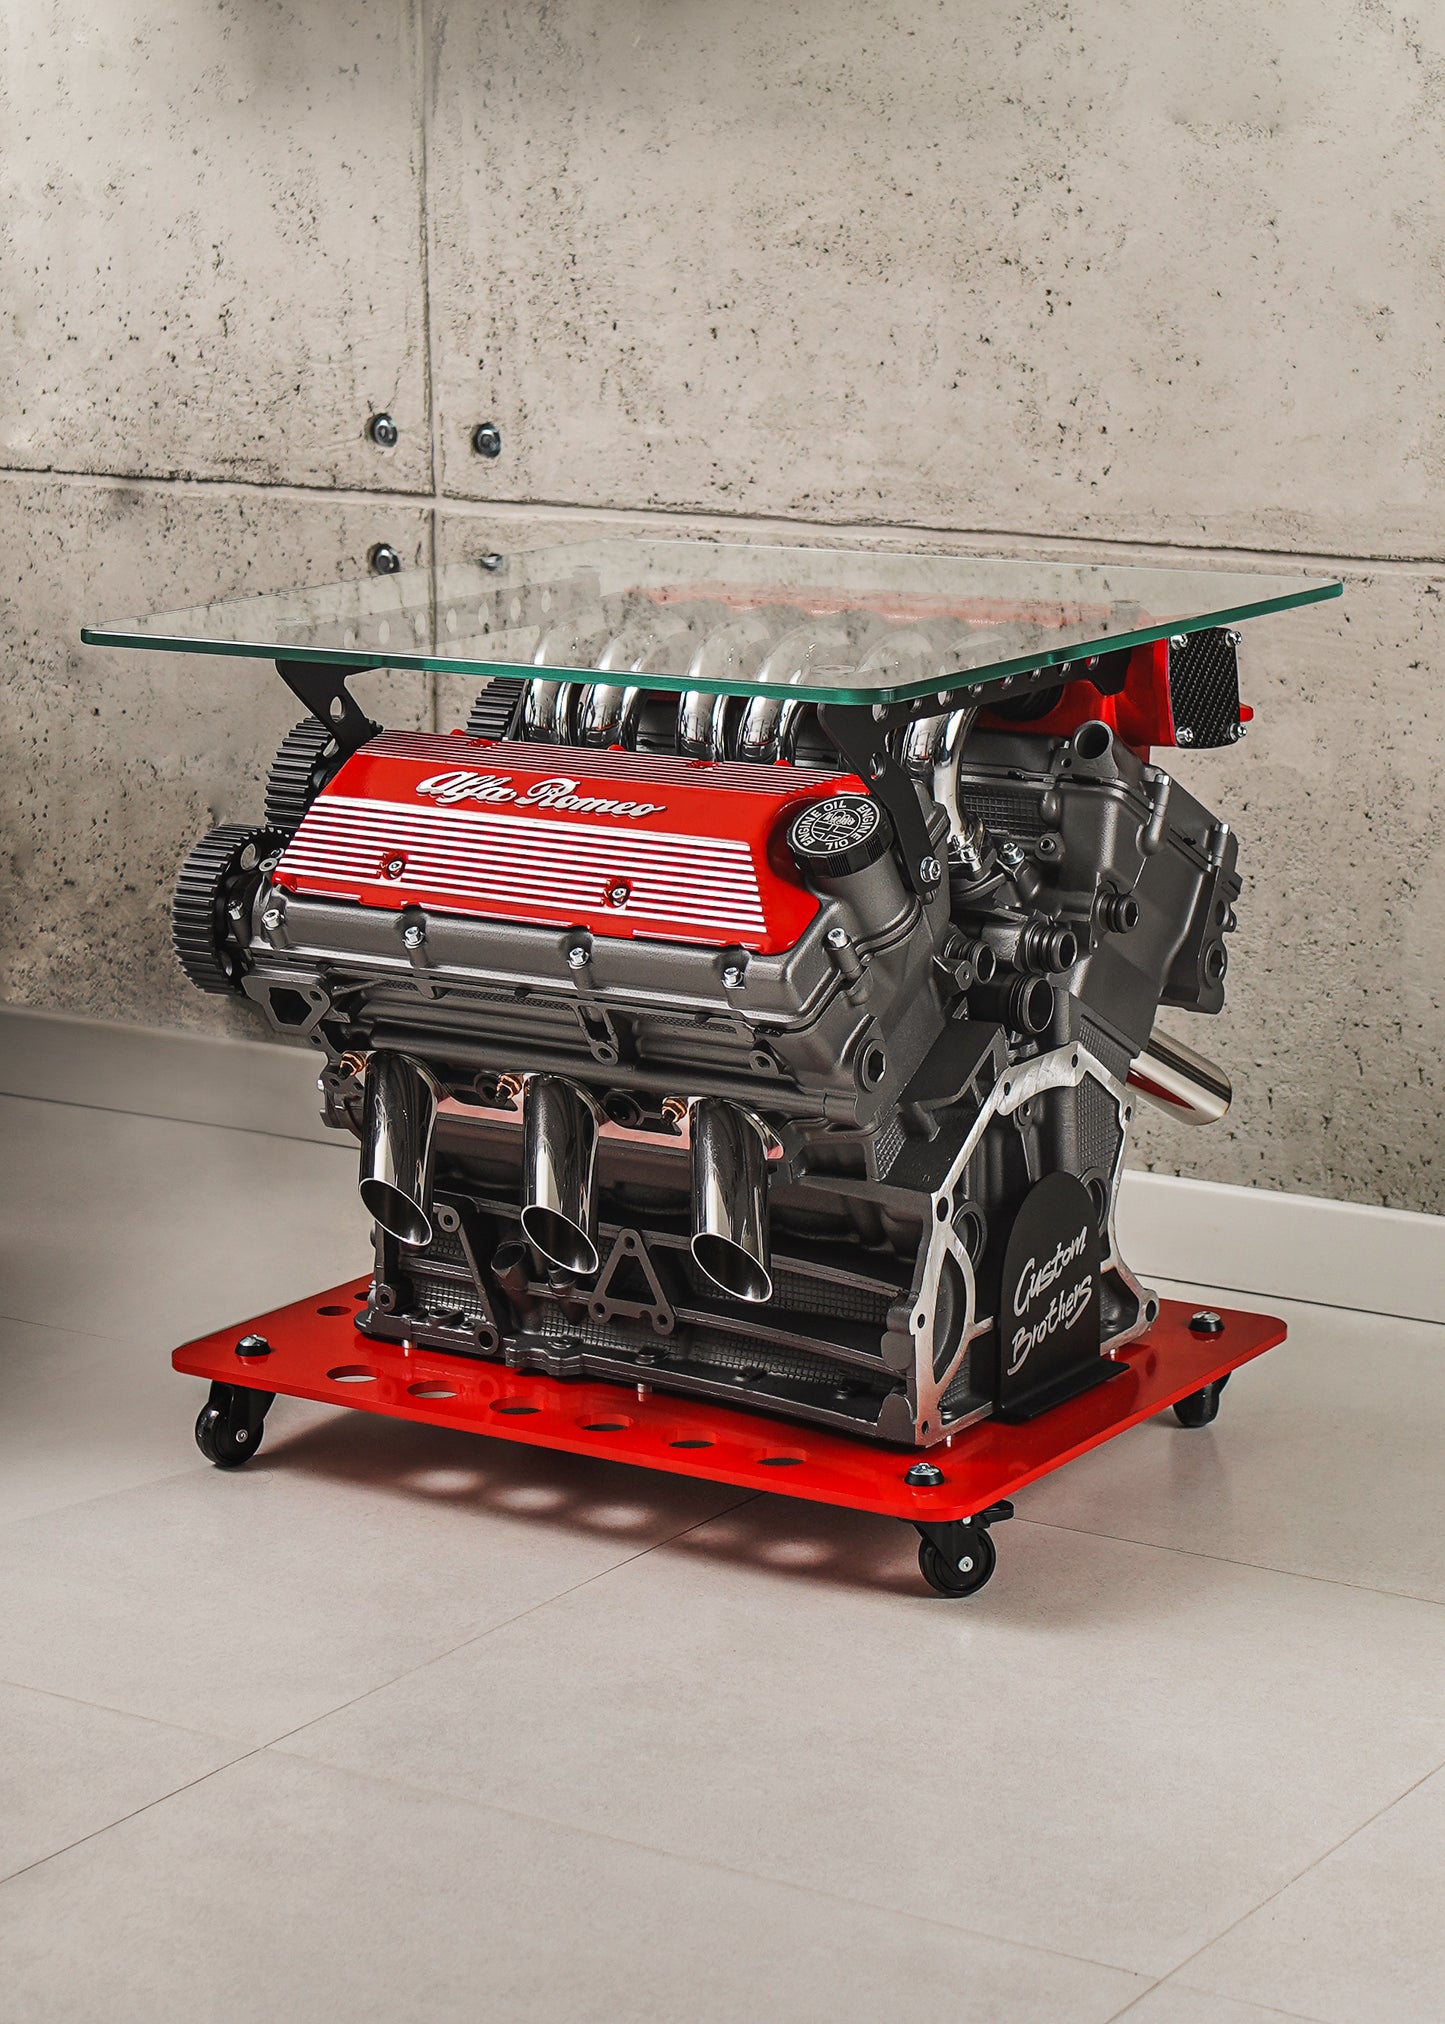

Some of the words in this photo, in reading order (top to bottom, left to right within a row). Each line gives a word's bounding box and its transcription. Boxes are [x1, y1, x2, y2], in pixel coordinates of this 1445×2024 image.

[416, 770, 518, 805] Alfa
[514, 777, 668, 817] Romeo
[798, 809, 821, 847] ENGINE
[823, 800, 847, 811] OIL
[825, 840, 848, 850] OIL
[851, 803, 874, 840] ENGINE
[1013, 1226, 1088, 1317] Custom
[1007, 1275, 1093, 1376] Brothers
